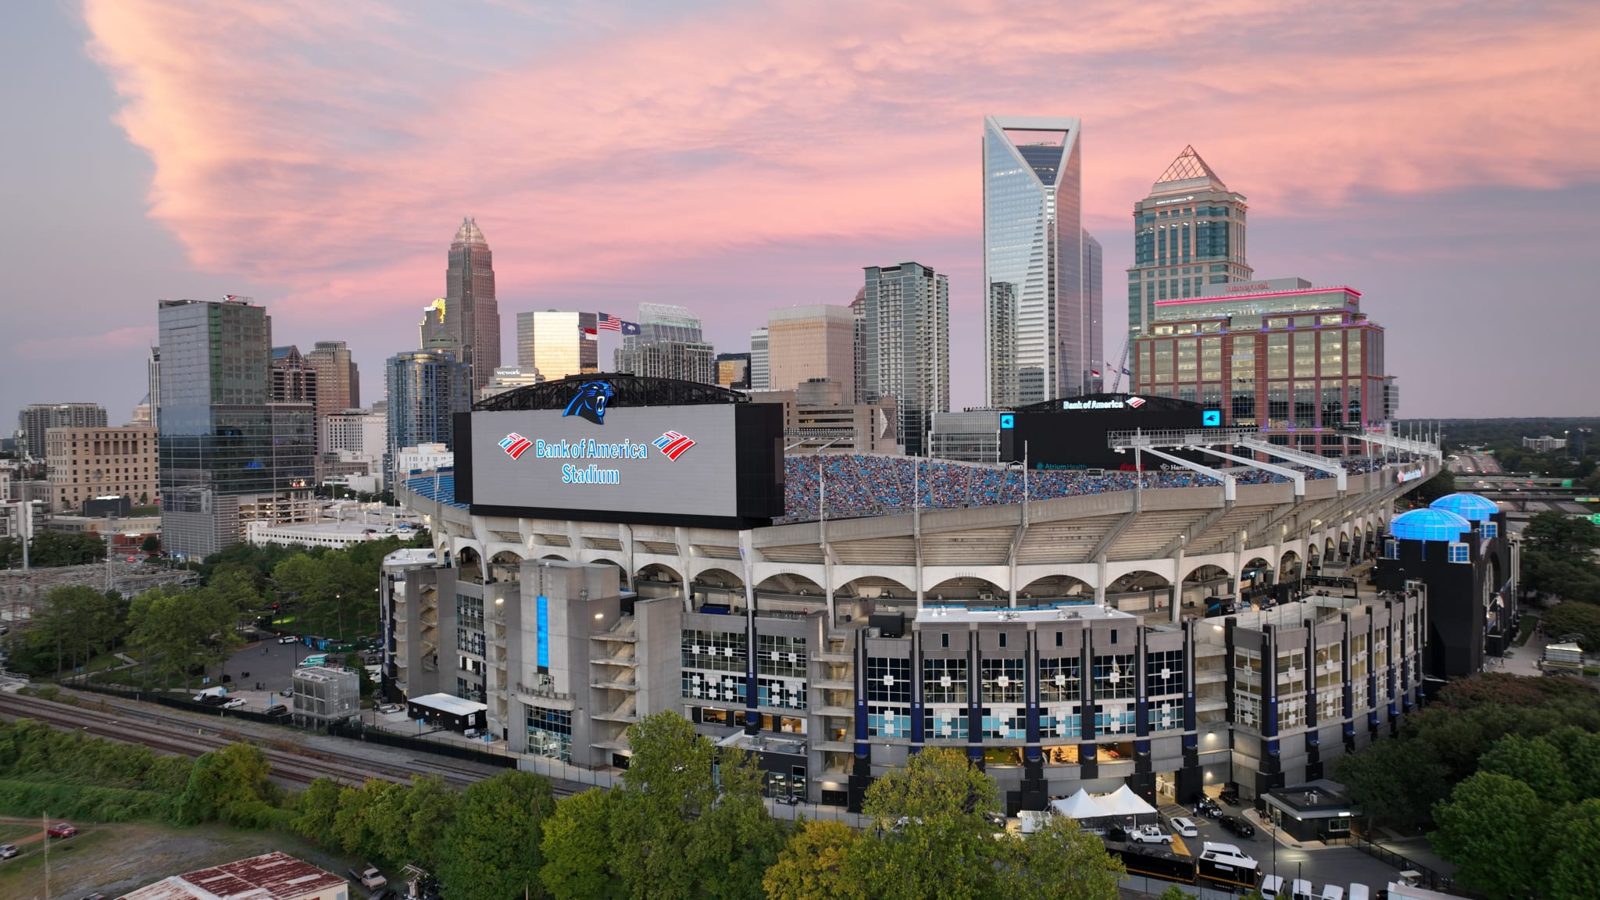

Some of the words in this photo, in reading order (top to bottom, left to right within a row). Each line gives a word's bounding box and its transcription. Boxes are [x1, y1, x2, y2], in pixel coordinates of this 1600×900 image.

[1063, 400, 1082, 410] Bank
[1083, 400, 1091, 409] of
[1092, 400, 1124, 409] America
[536, 438, 571, 459] Bank
[571, 438, 586, 459] of
[587, 438, 648, 459] America
[562, 464, 620, 484] Stadium
